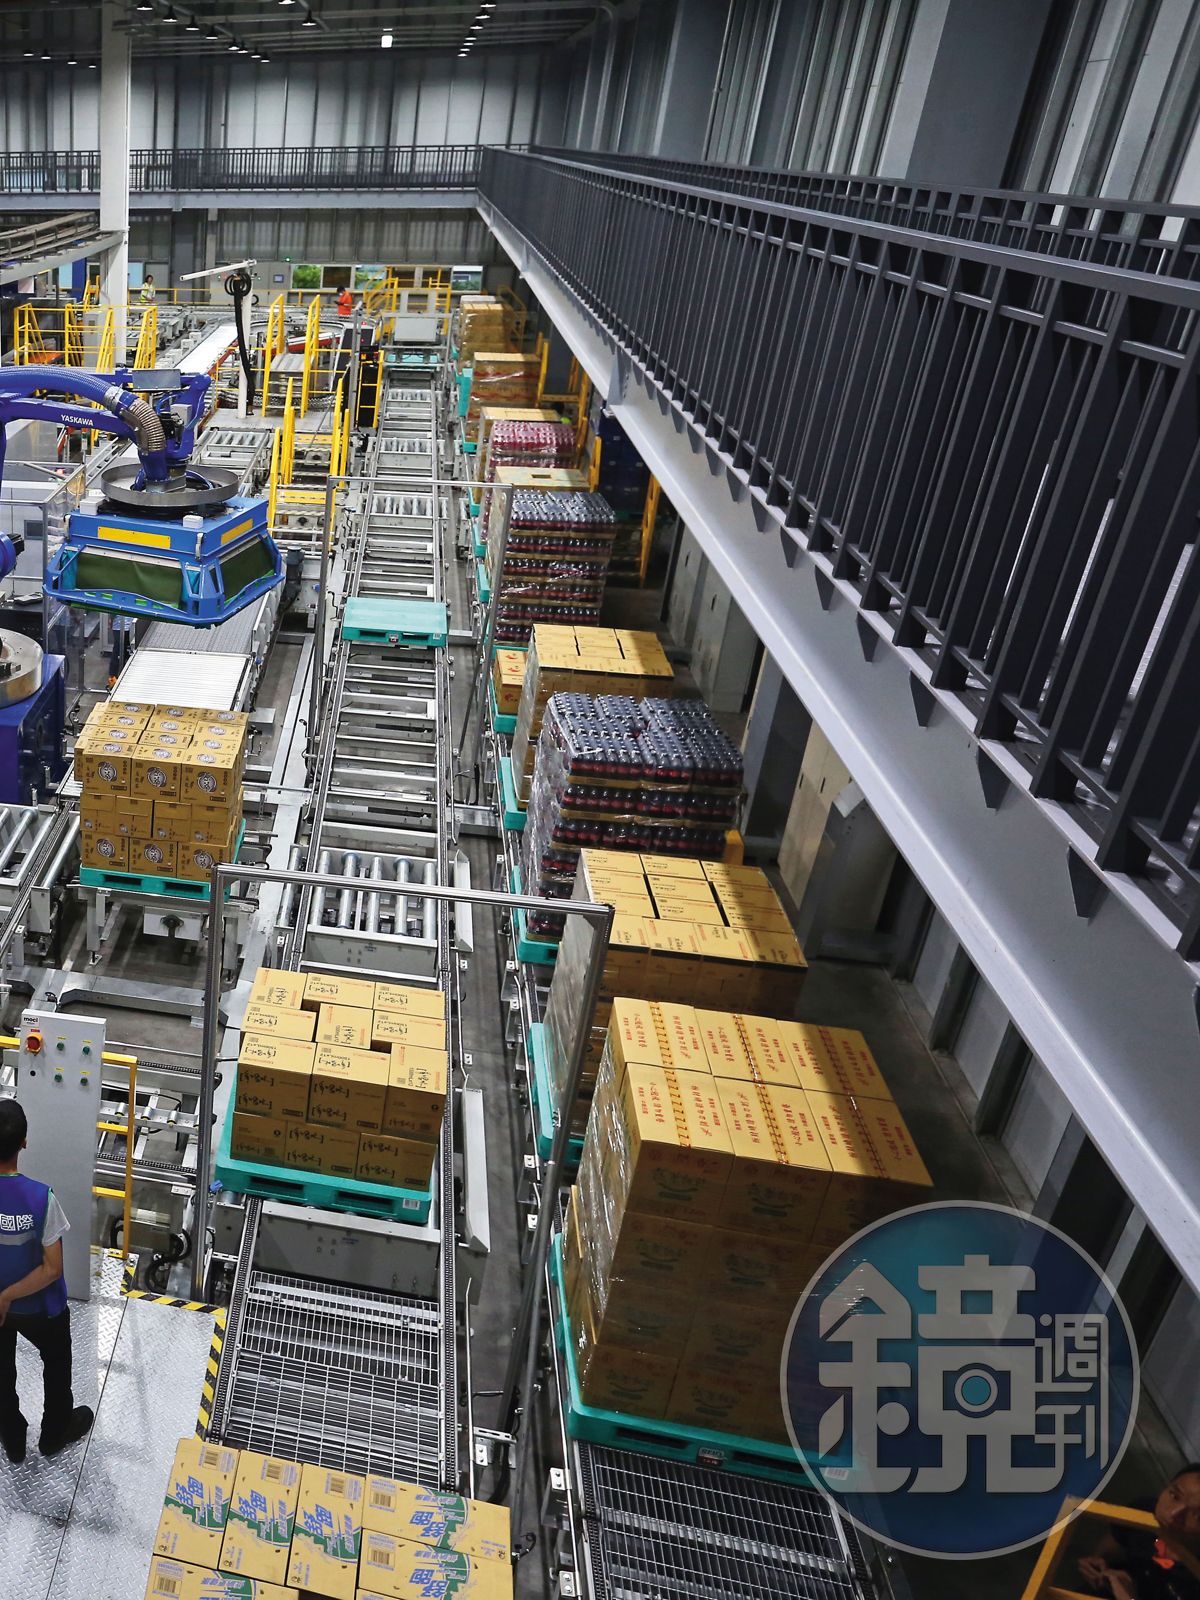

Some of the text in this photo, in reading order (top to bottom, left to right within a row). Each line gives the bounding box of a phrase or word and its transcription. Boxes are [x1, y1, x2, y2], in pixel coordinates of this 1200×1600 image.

[61, 414, 94, 426] YASKAWA
[175, 1475, 204, 1509] 舒跑
[238, 1489, 268, 1523] 舒跑
[302, 1503, 334, 1538] 舒跑
[410, 1510, 449, 1539] 舒跑
[409, 1568, 449, 1598] 舒跑
